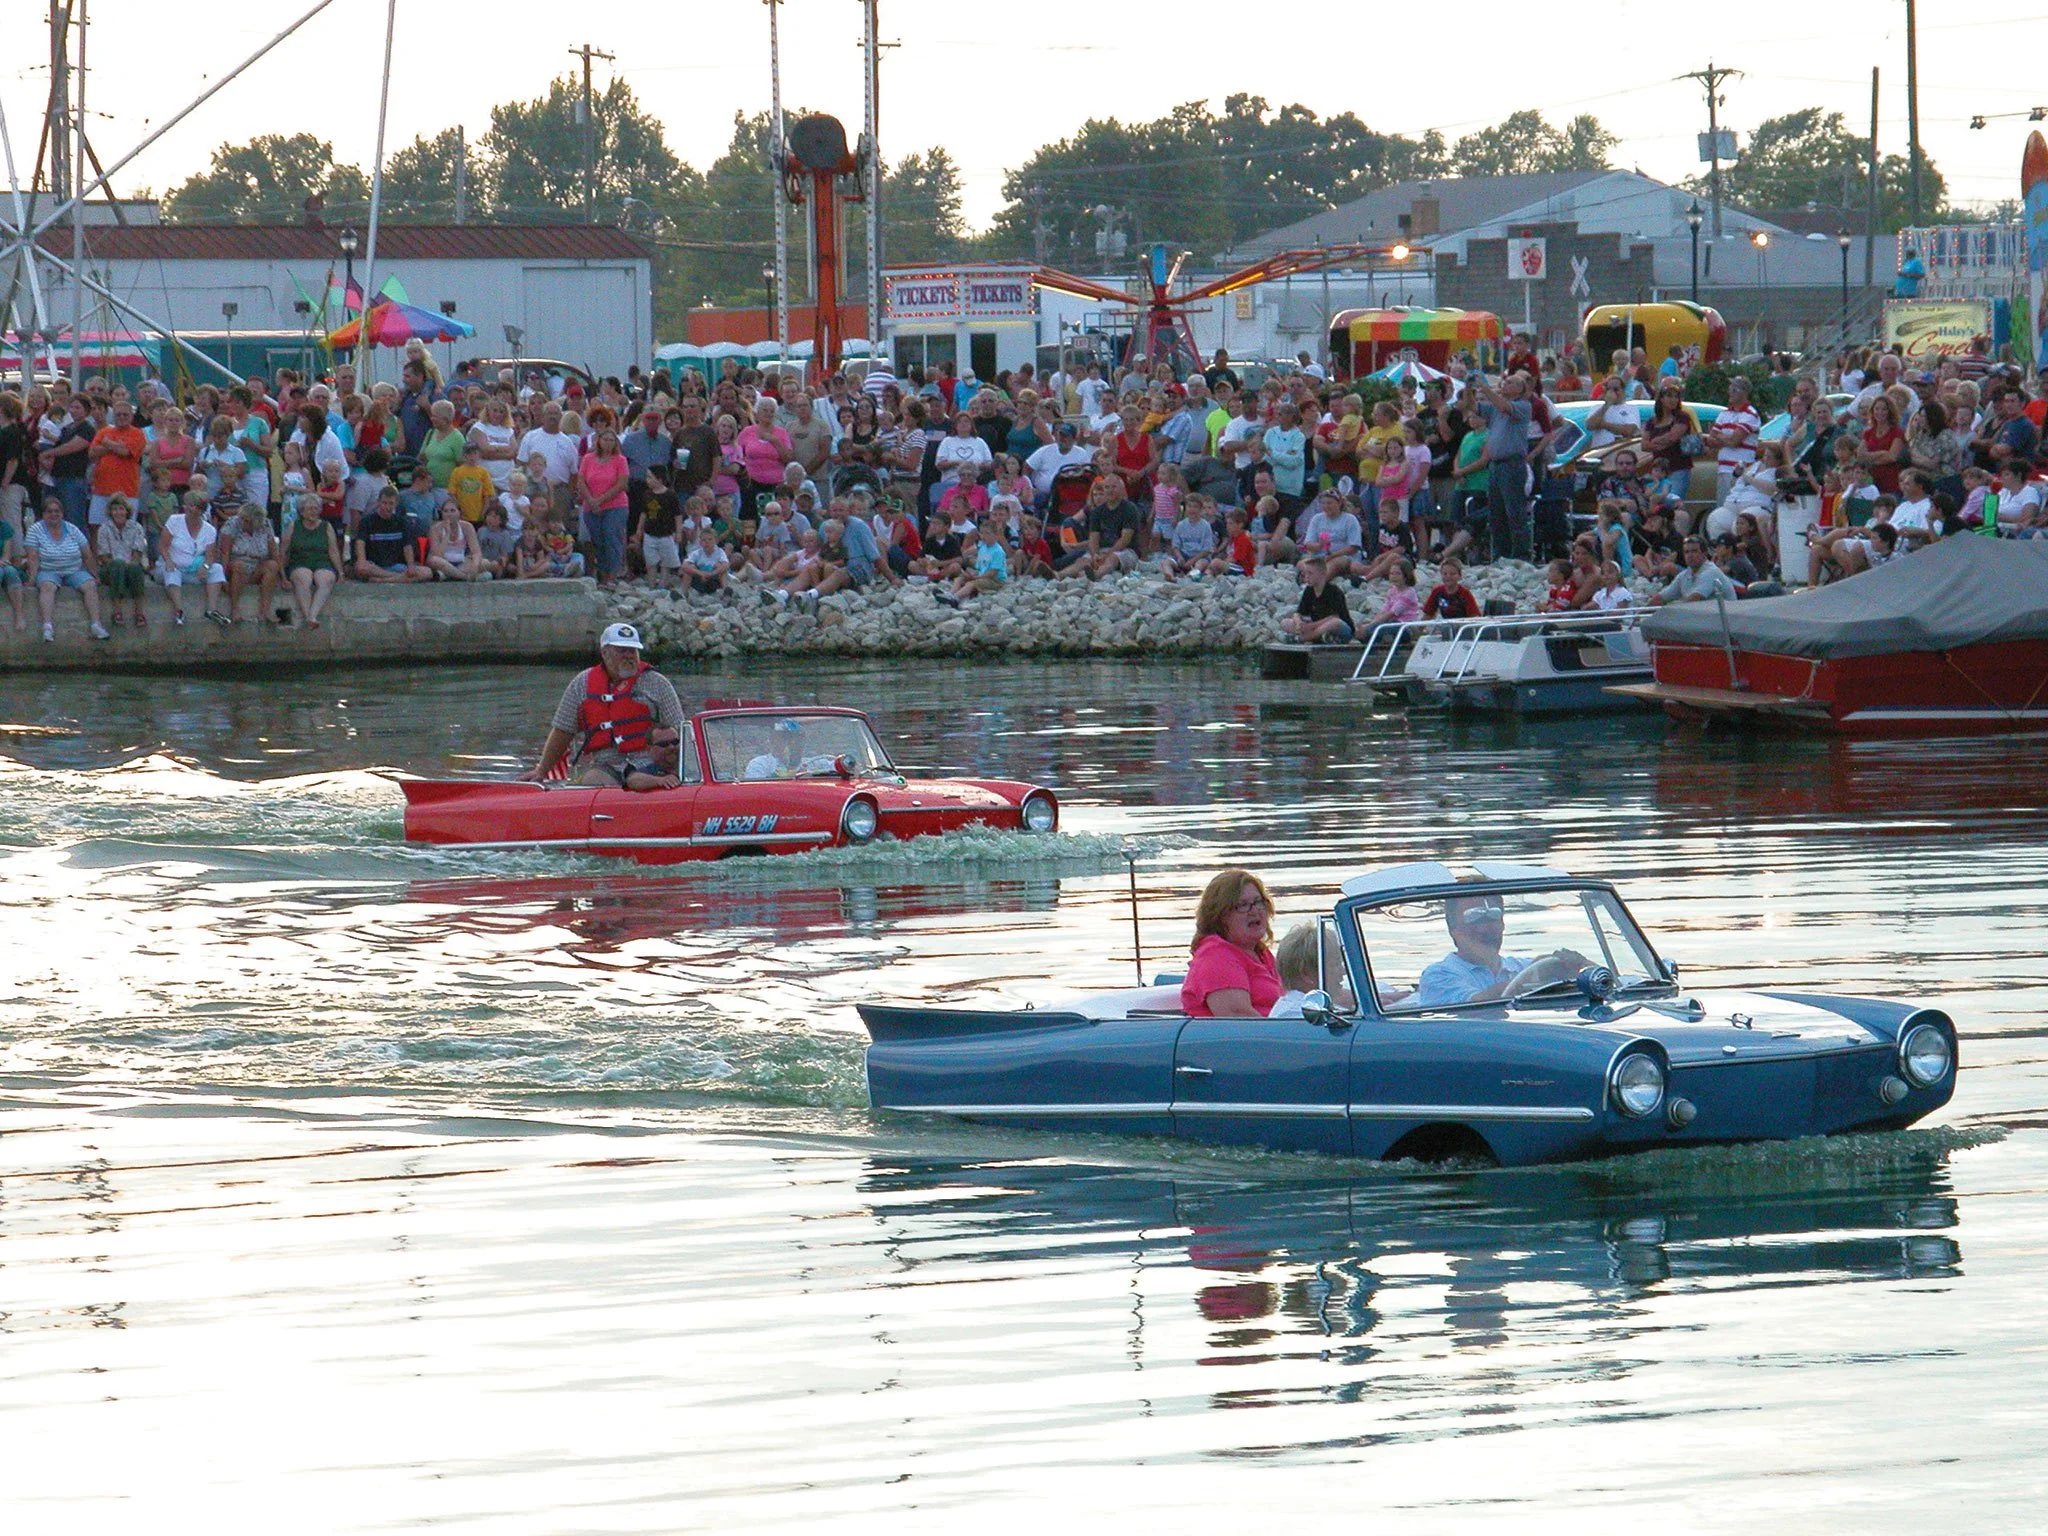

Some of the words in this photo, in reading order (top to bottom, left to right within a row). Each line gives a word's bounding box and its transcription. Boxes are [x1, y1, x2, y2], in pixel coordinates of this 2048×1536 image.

[896, 285, 957, 306] TICKETS
[971, 284, 1023, 304] TICKETS
[723, 815, 756, 833] 5529
